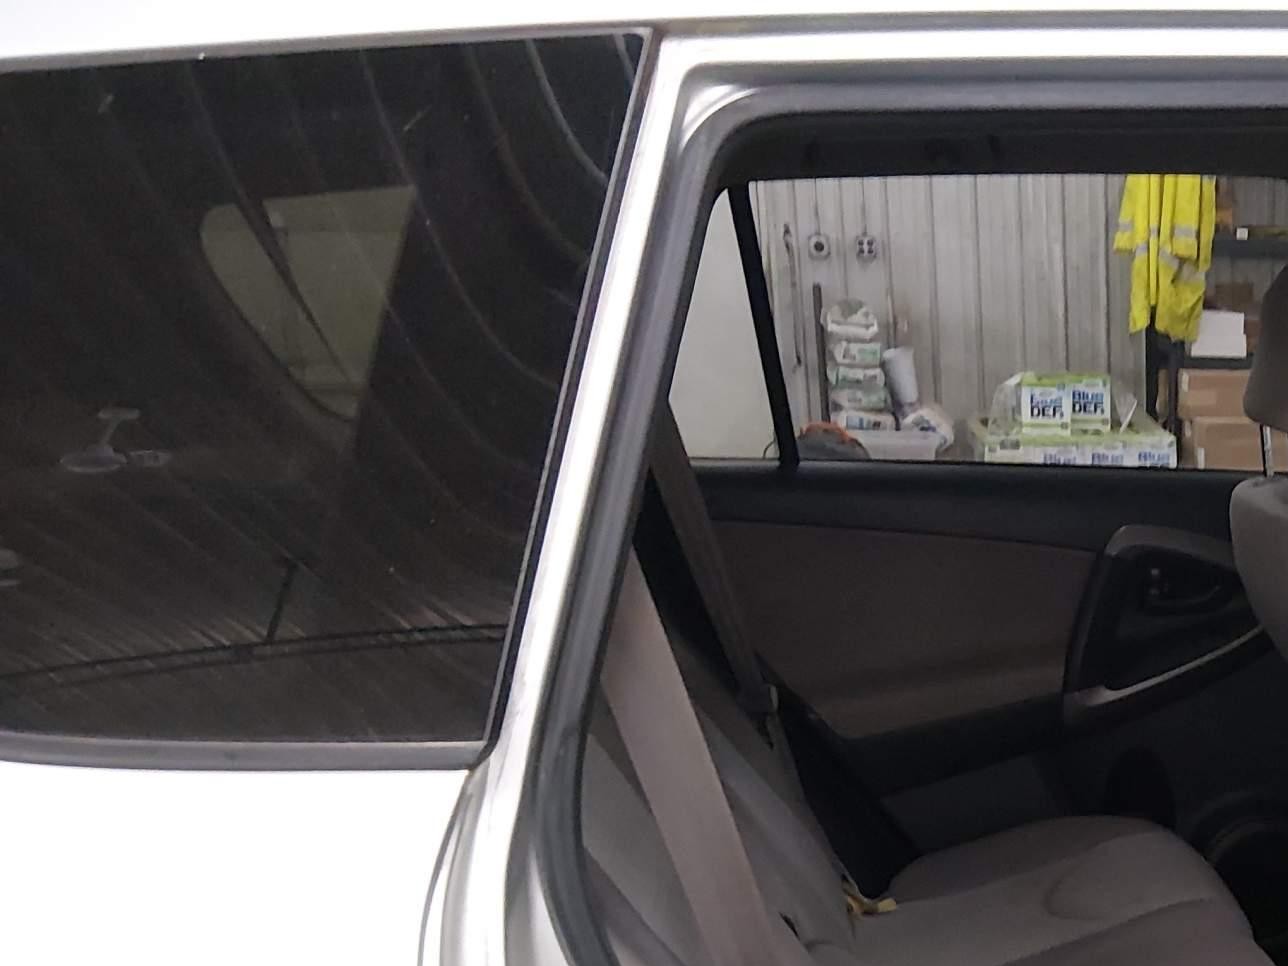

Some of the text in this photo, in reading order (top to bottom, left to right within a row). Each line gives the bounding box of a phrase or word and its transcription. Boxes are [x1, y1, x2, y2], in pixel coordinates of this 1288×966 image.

[1071, 389, 1104, 401] Blue
[1030, 405, 1064, 418] DEF
[1071, 401, 1104, 414] DEF
